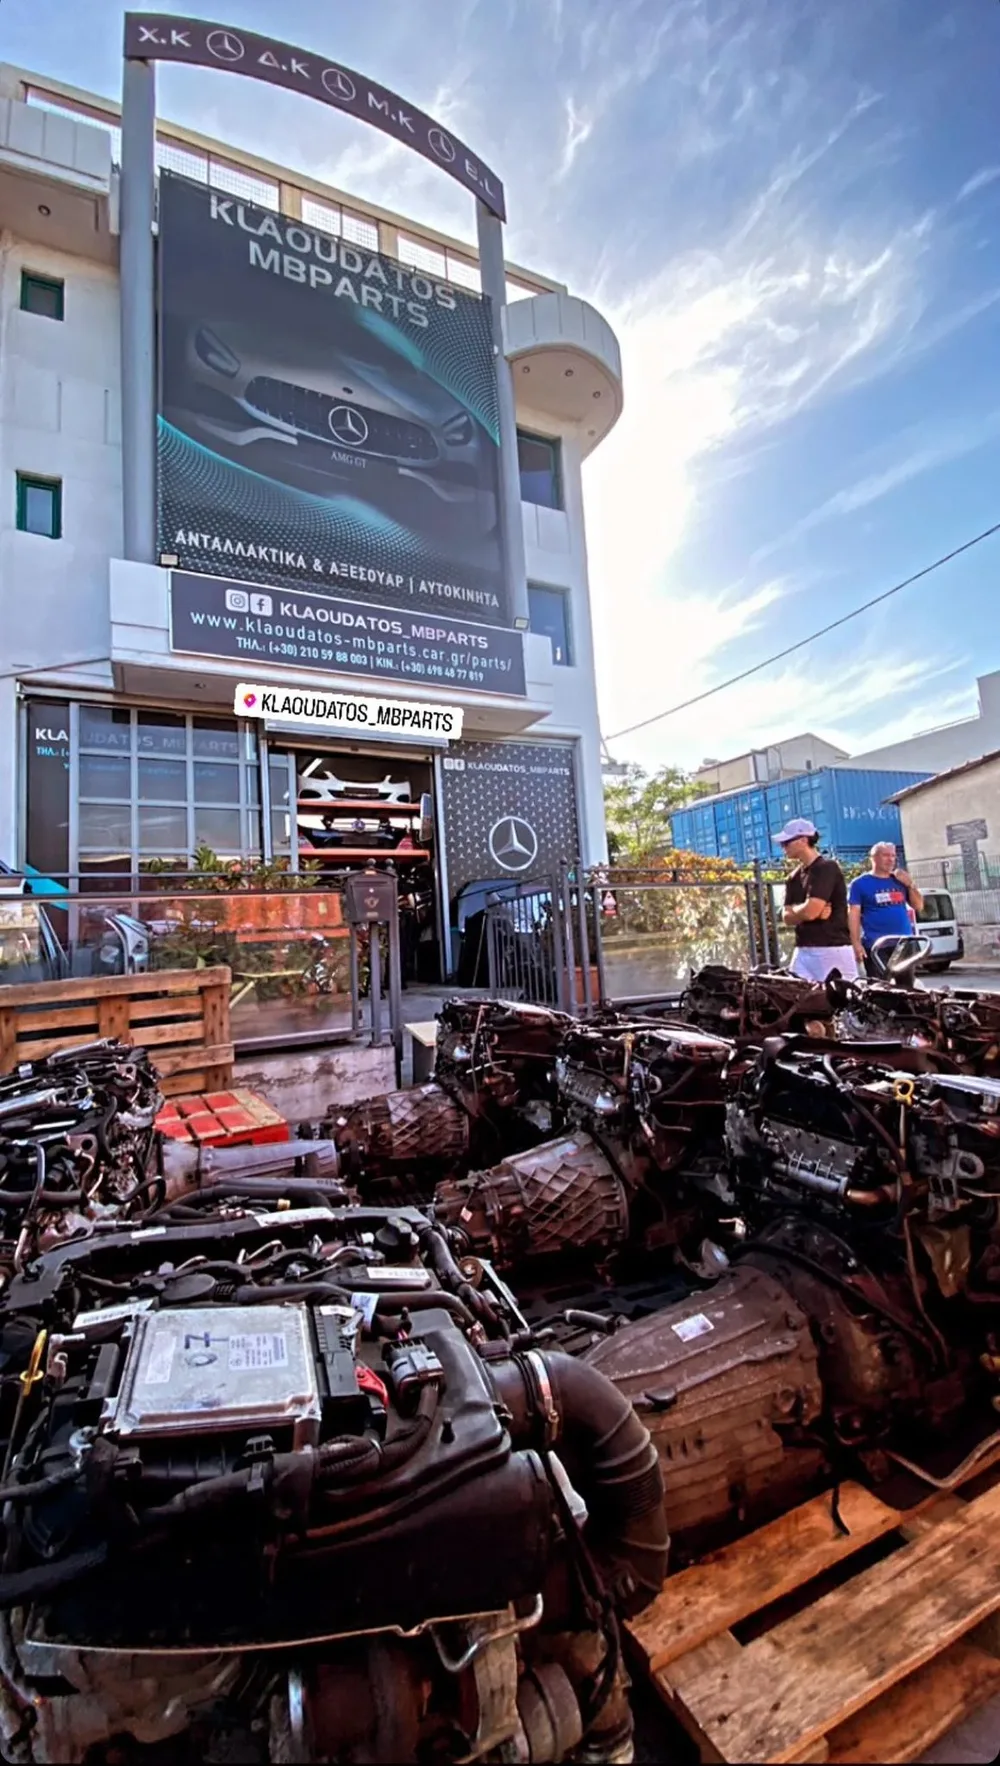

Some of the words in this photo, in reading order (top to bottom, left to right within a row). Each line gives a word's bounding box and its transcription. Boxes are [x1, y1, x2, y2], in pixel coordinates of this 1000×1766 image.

[210, 195, 456, 311] KLAOUDATOS
[249, 240, 429, 328] MBPARTS
[330, 451, 353, 465] AMG
[355, 456, 368, 469] GT
[175, 529, 307, 569] ΑΝΤΑΛΛΑΚΤΙΚΑ
[312, 558, 323, 572] &
[329, 562, 403, 588] ΑΞΕΣΟΥΑΡ
[419, 580, 500, 608] ΑΥΤΟΚΙΝΗΤΑ
[190, 611, 512, 672] www.klaoudatos-mbparts.car.gr/parts/
[280, 602, 488, 649] KLAOUDATOS_MBPARTS
[269, 641, 297, 656] (+30)
[300, 646, 318, 659] 210
[321, 649, 333, 661] 59
[336, 652, 348, 663] 88
[401, 661, 425, 675] (+30)
[456, 669, 467, 680] 77
